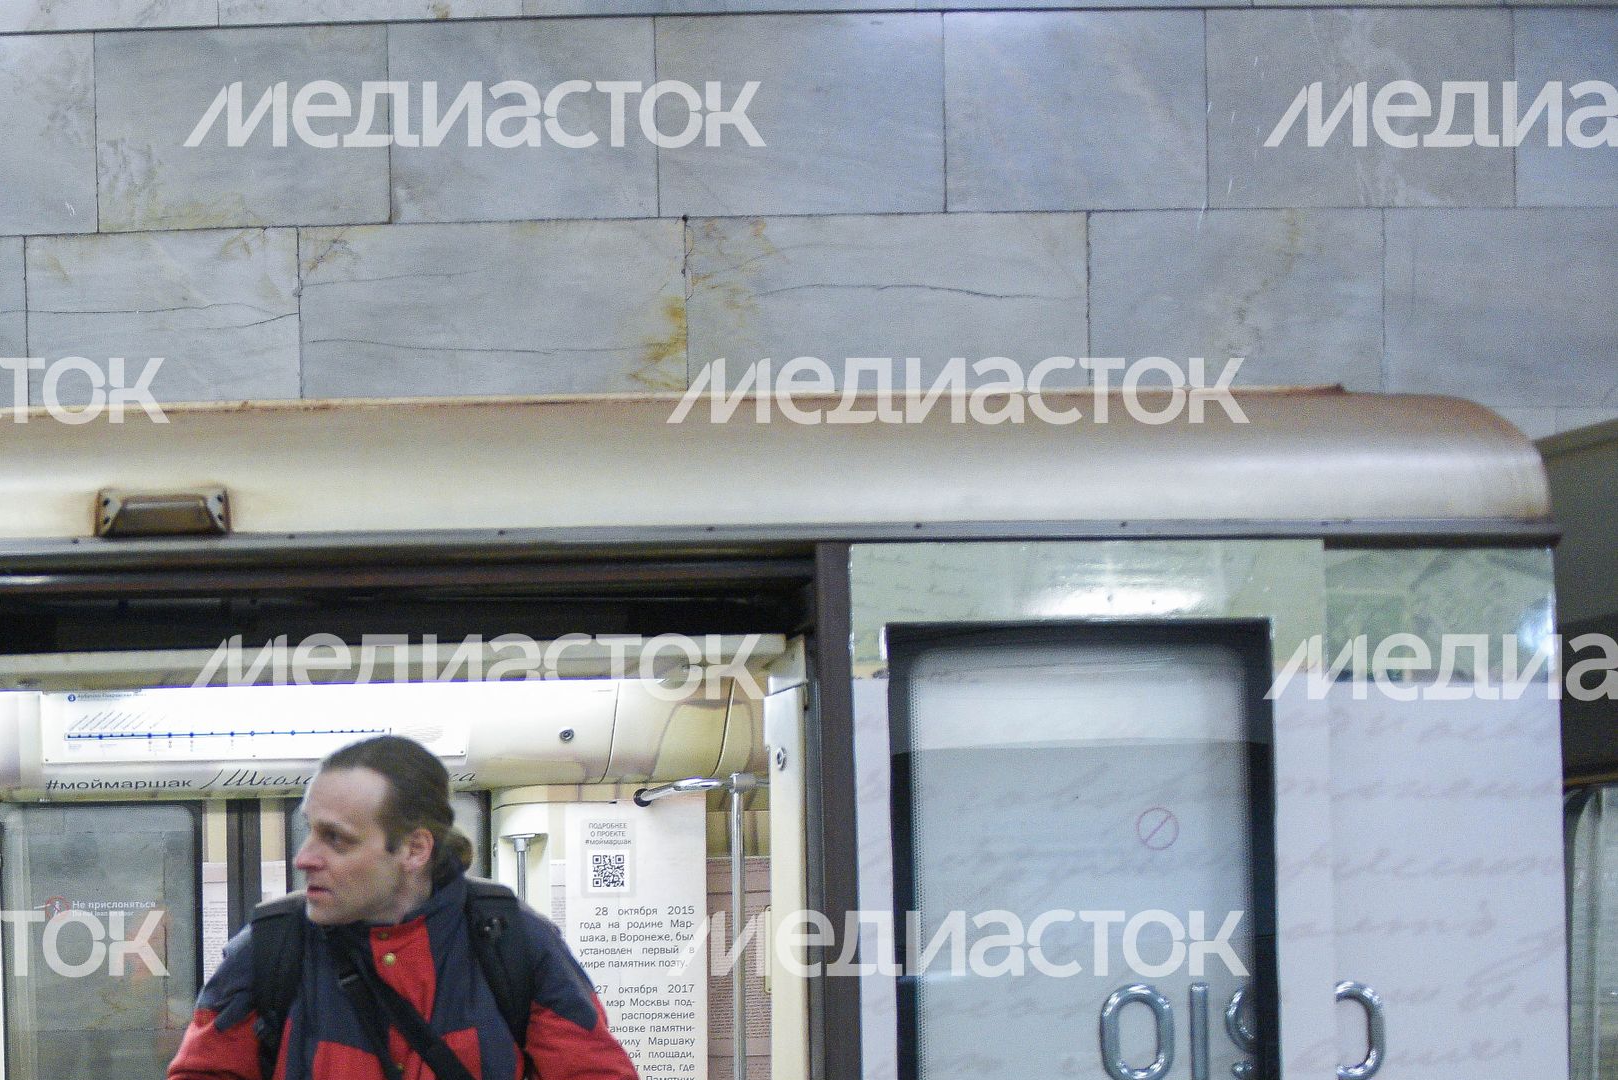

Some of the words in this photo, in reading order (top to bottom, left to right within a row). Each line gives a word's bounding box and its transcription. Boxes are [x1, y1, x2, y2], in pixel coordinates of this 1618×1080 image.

[46, 779, 192, 790] #моймаршак
[585, 838, 632, 846] #моймаршак
[72, 900, 86, 908] Не
[88, 901, 156, 910] прислоняться
[595, 907, 609, 916] 28
[617, 906, 658, 917] октября
[667, 905, 695, 916] 2015
[579, 921, 601, 930] года
[608, 921, 620, 929] на
[627, 920, 663, 930] родине
[670, 919, 695, 929] Мар-
[579, 935, 609, 943] шака,
[611, 934, 617, 942] в
[619, 932, 673, 943] Воронеже,
[675, 931, 695, 941] был
[579, 947, 633, 956] установлен
[641, 945, 679, 956] первый
[580, 960, 606, 970] мире
[608, 960, 657, 968] памятник
[618, 984, 658, 995] октября
[667, 983, 695, 994] 2017
[606, 999, 626, 1008] мэр
[629, 997, 670, 1007] Москвы
[674, 998, 695, 1007] под-
[621, 1011, 695, 1021] распоряжение
[649, 1024, 695, 1033] памятни-
[648, 1036, 695, 1047] Маршаку
[648, 1050, 695, 1060] площади,
[643, 1064, 676, 1073] места,
[679, 1064, 695, 1073] где
